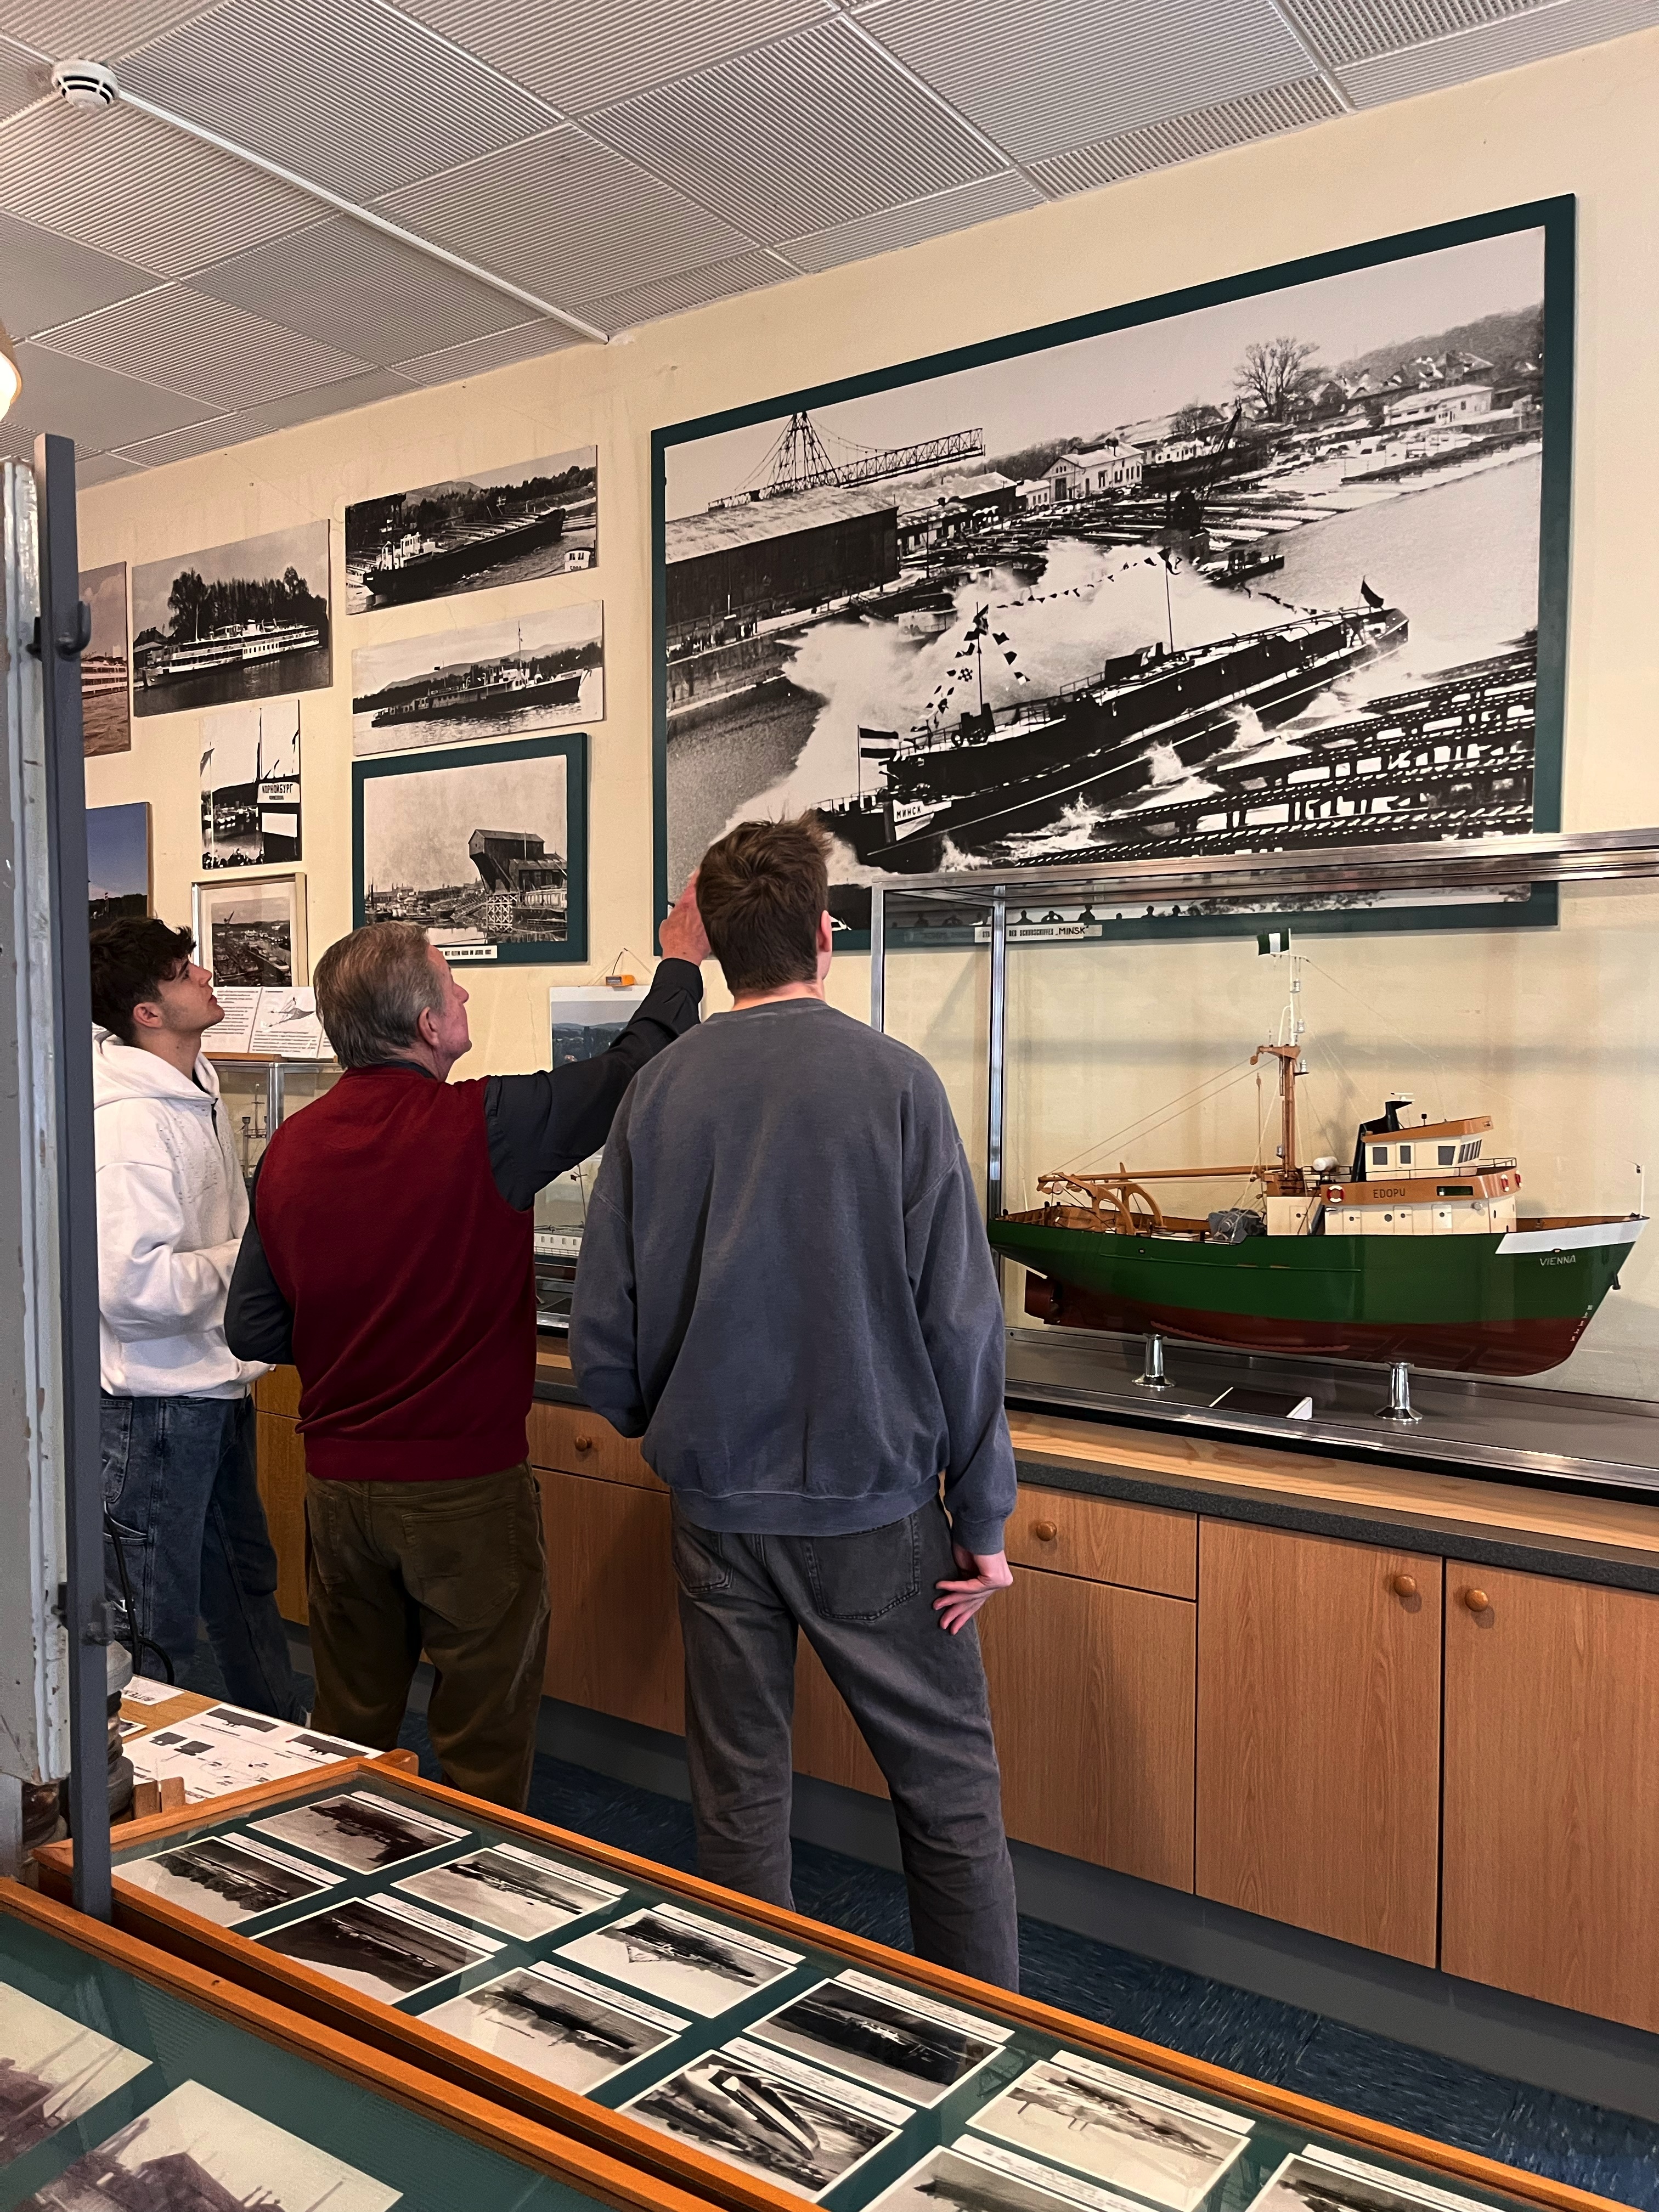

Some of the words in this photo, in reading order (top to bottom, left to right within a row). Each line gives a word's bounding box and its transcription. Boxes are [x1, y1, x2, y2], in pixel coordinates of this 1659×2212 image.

[896, 806, 921, 819] МИНСК
[1373, 1188, 1406, 1198] EDOPU
[1539, 1255, 1576, 1266] VIENNA
